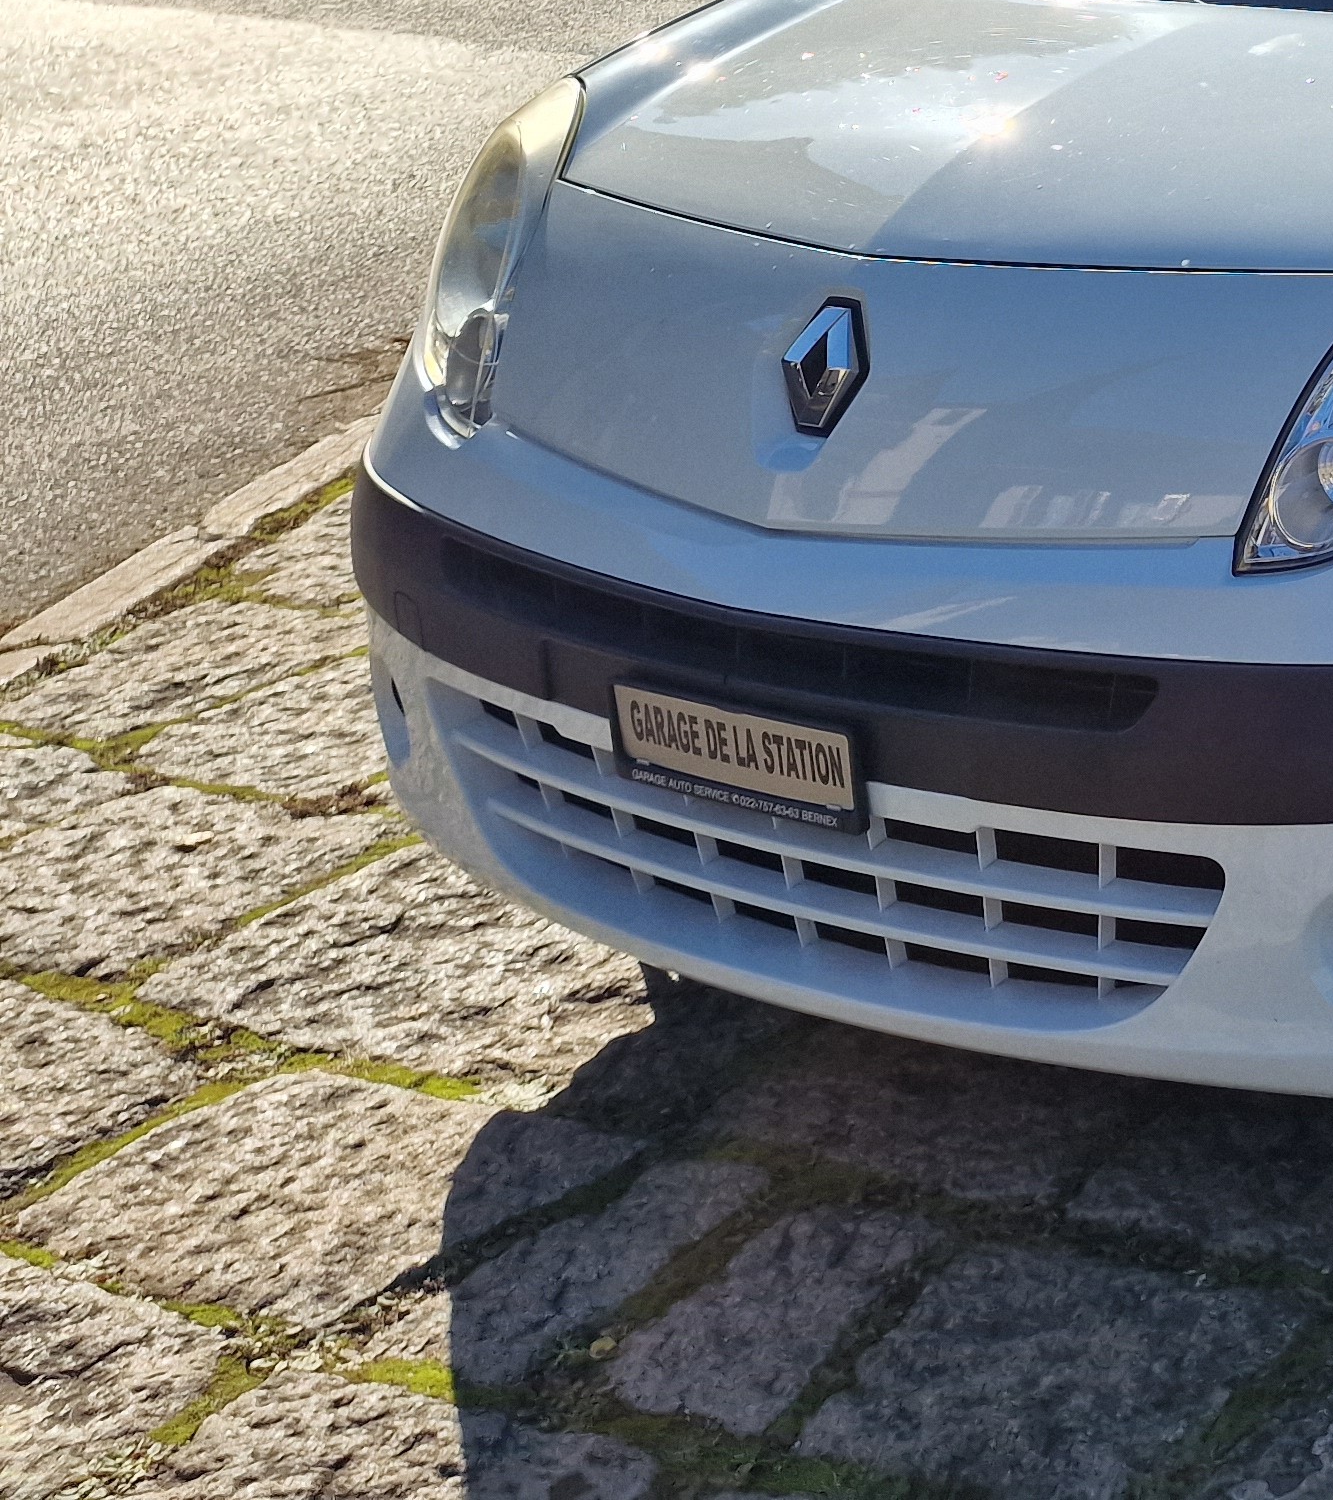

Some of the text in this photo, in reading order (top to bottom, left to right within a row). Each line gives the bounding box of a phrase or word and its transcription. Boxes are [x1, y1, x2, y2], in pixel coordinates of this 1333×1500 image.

[630, 700, 845, 788] GARAGE DE LA STATION
[632, 769, 667, 786] GARAGE
[668, 779, 692, 793] AUTO
[694, 785, 730, 803] SERVICE
[801, 810, 838, 828] BERNEX
